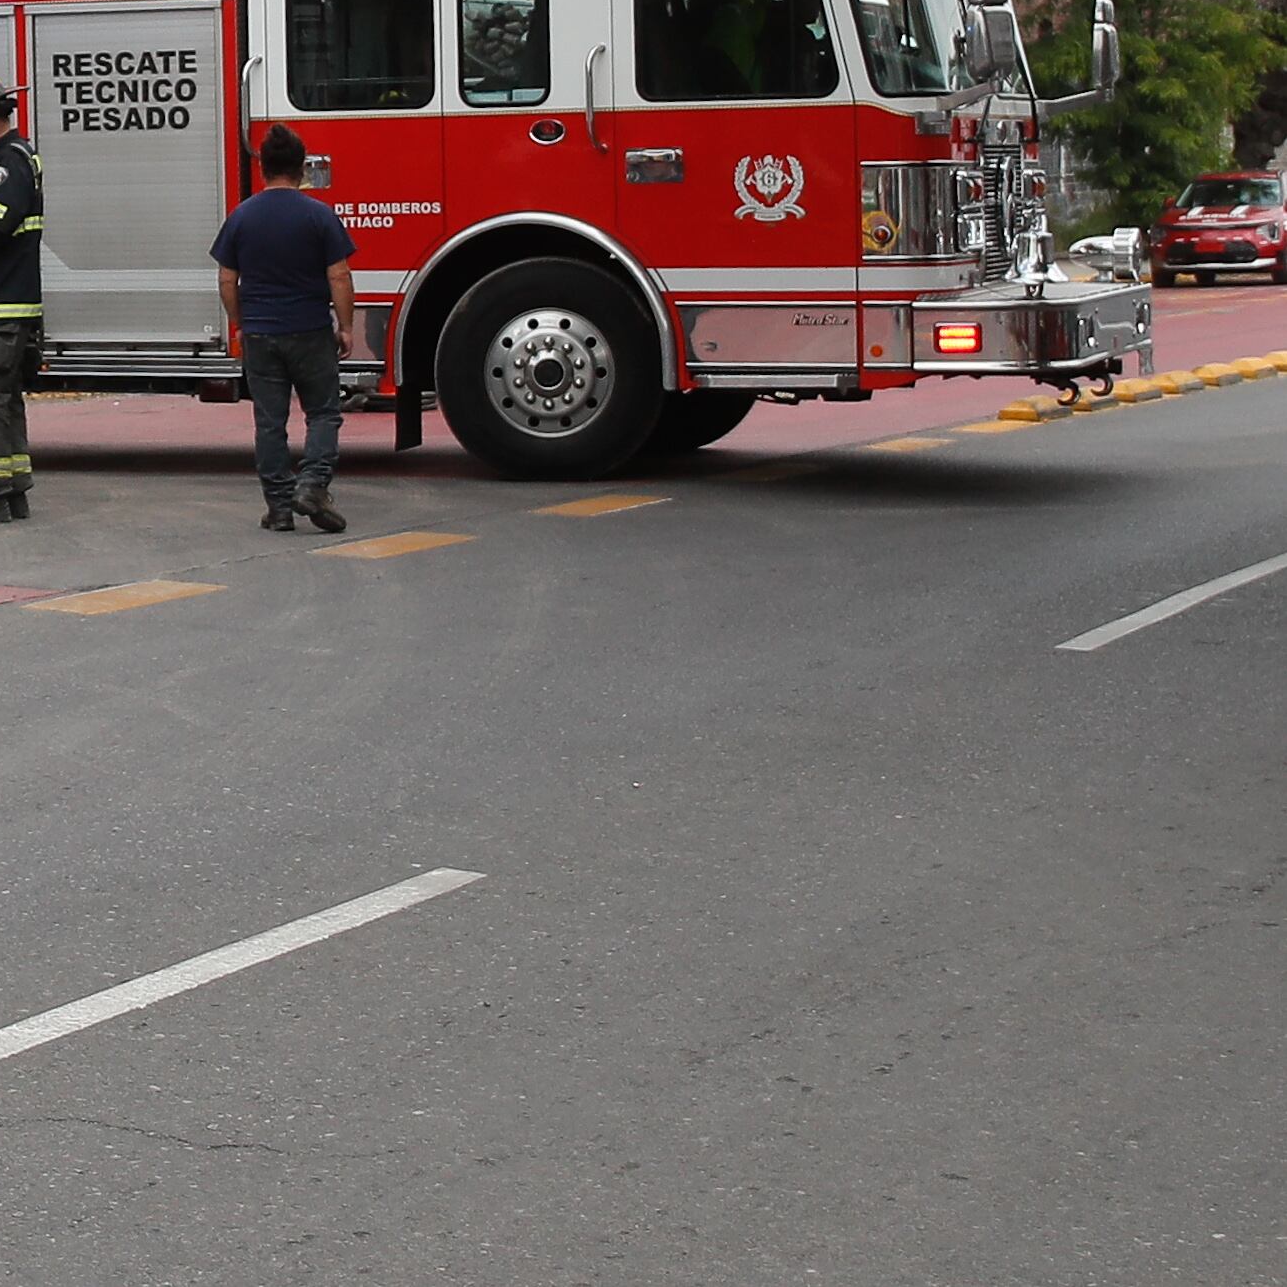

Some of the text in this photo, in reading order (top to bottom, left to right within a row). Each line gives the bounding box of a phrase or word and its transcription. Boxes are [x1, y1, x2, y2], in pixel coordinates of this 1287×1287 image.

[52, 50, 197, 77] RESCATE
[53, 78, 197, 104] TECNICO
[62, 106, 190, 131] PESADO
[334, 202, 442, 214] DE BOMBEROS
[339, 216, 394, 228] NTIAGO
